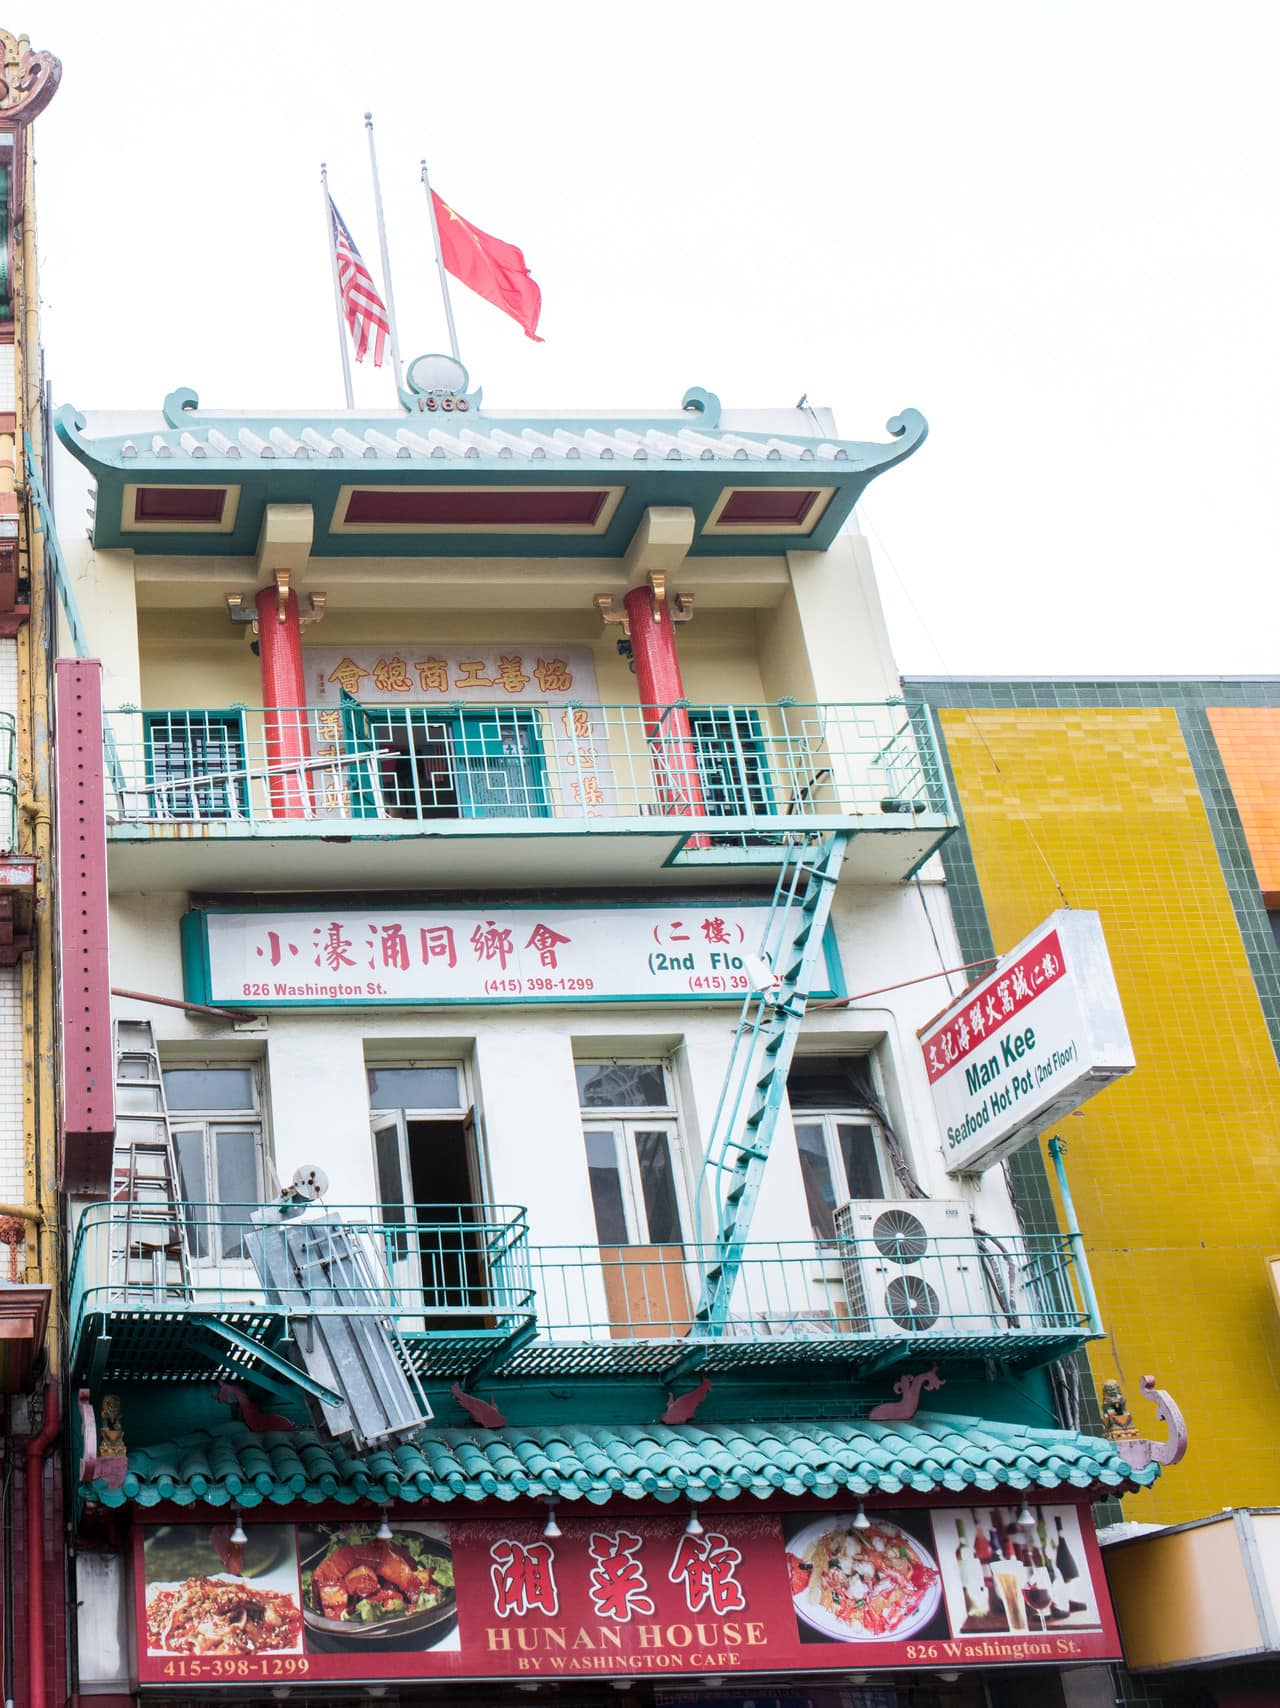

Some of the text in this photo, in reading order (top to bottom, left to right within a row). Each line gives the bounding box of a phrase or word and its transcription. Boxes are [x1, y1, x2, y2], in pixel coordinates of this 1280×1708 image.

[418, 397, 469, 412] 1960
[328, 656, 573, 693] 協善工商總會
[256, 921, 571, 971] 小濠涌同鄉會
[648, 952, 772, 975] (2nd Flo)
[242, 982, 387, 998] 826 Washington St.
[484, 978, 595, 994] (415) 398-1299
[688, 976, 727, 991] (415)
[965, 1027, 1036, 1097] Man Kee
[947, 1039, 1079, 1149] Seafood Hot Pot (2nd Floor)
[490, 1530, 746, 1622] 湘菜館
[485, 1622, 768, 1652] HUNAN HOUSE
[906, 1639, 1081, 1659] 826 Washington St.
[163, 1658, 310, 1676] 415-398-1299
[518, 1652, 741, 1670] BY WASHINGTON CAFE
